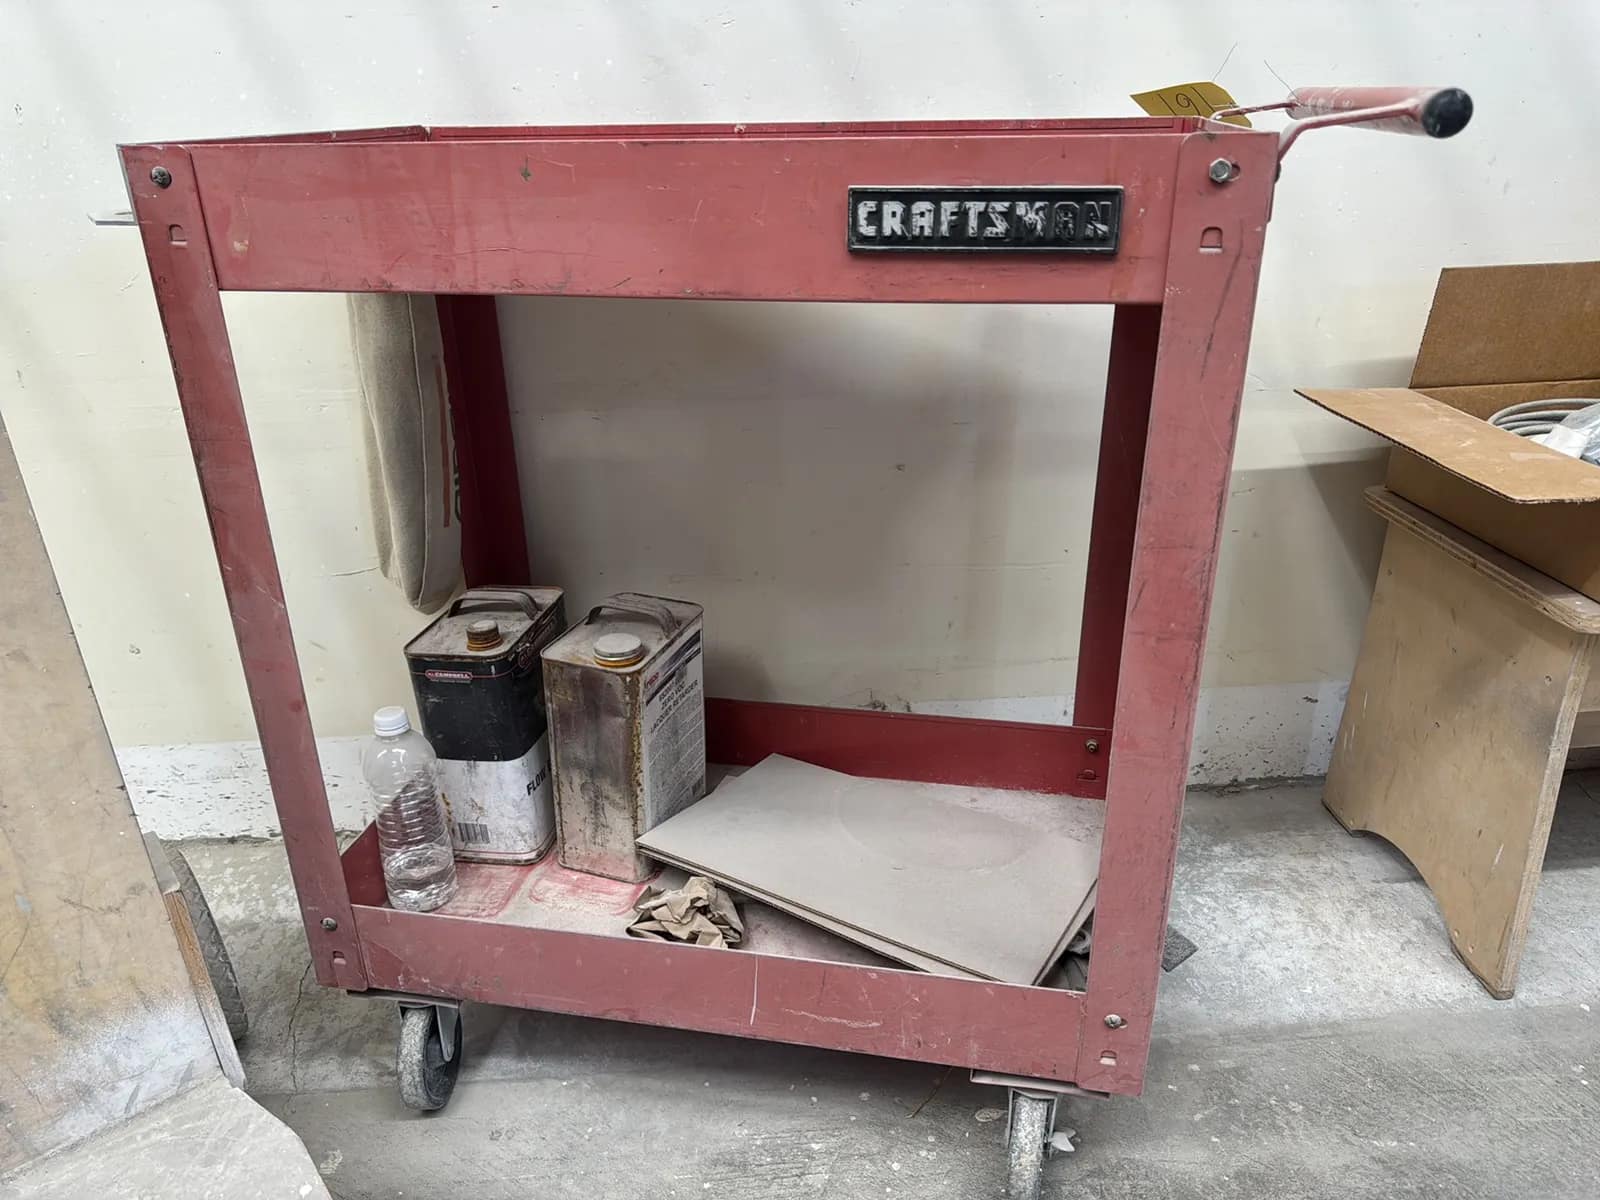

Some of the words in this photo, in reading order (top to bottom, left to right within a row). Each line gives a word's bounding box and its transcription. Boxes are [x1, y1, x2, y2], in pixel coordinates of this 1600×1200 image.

[856, 200, 1112, 240] CRAFTSMAN
[650, 704, 672, 734] LACQUER
[672, 679, 698, 706] RETARDER
[661, 692, 675, 711] ZERO
[526, 764, 546, 796] FLOW
